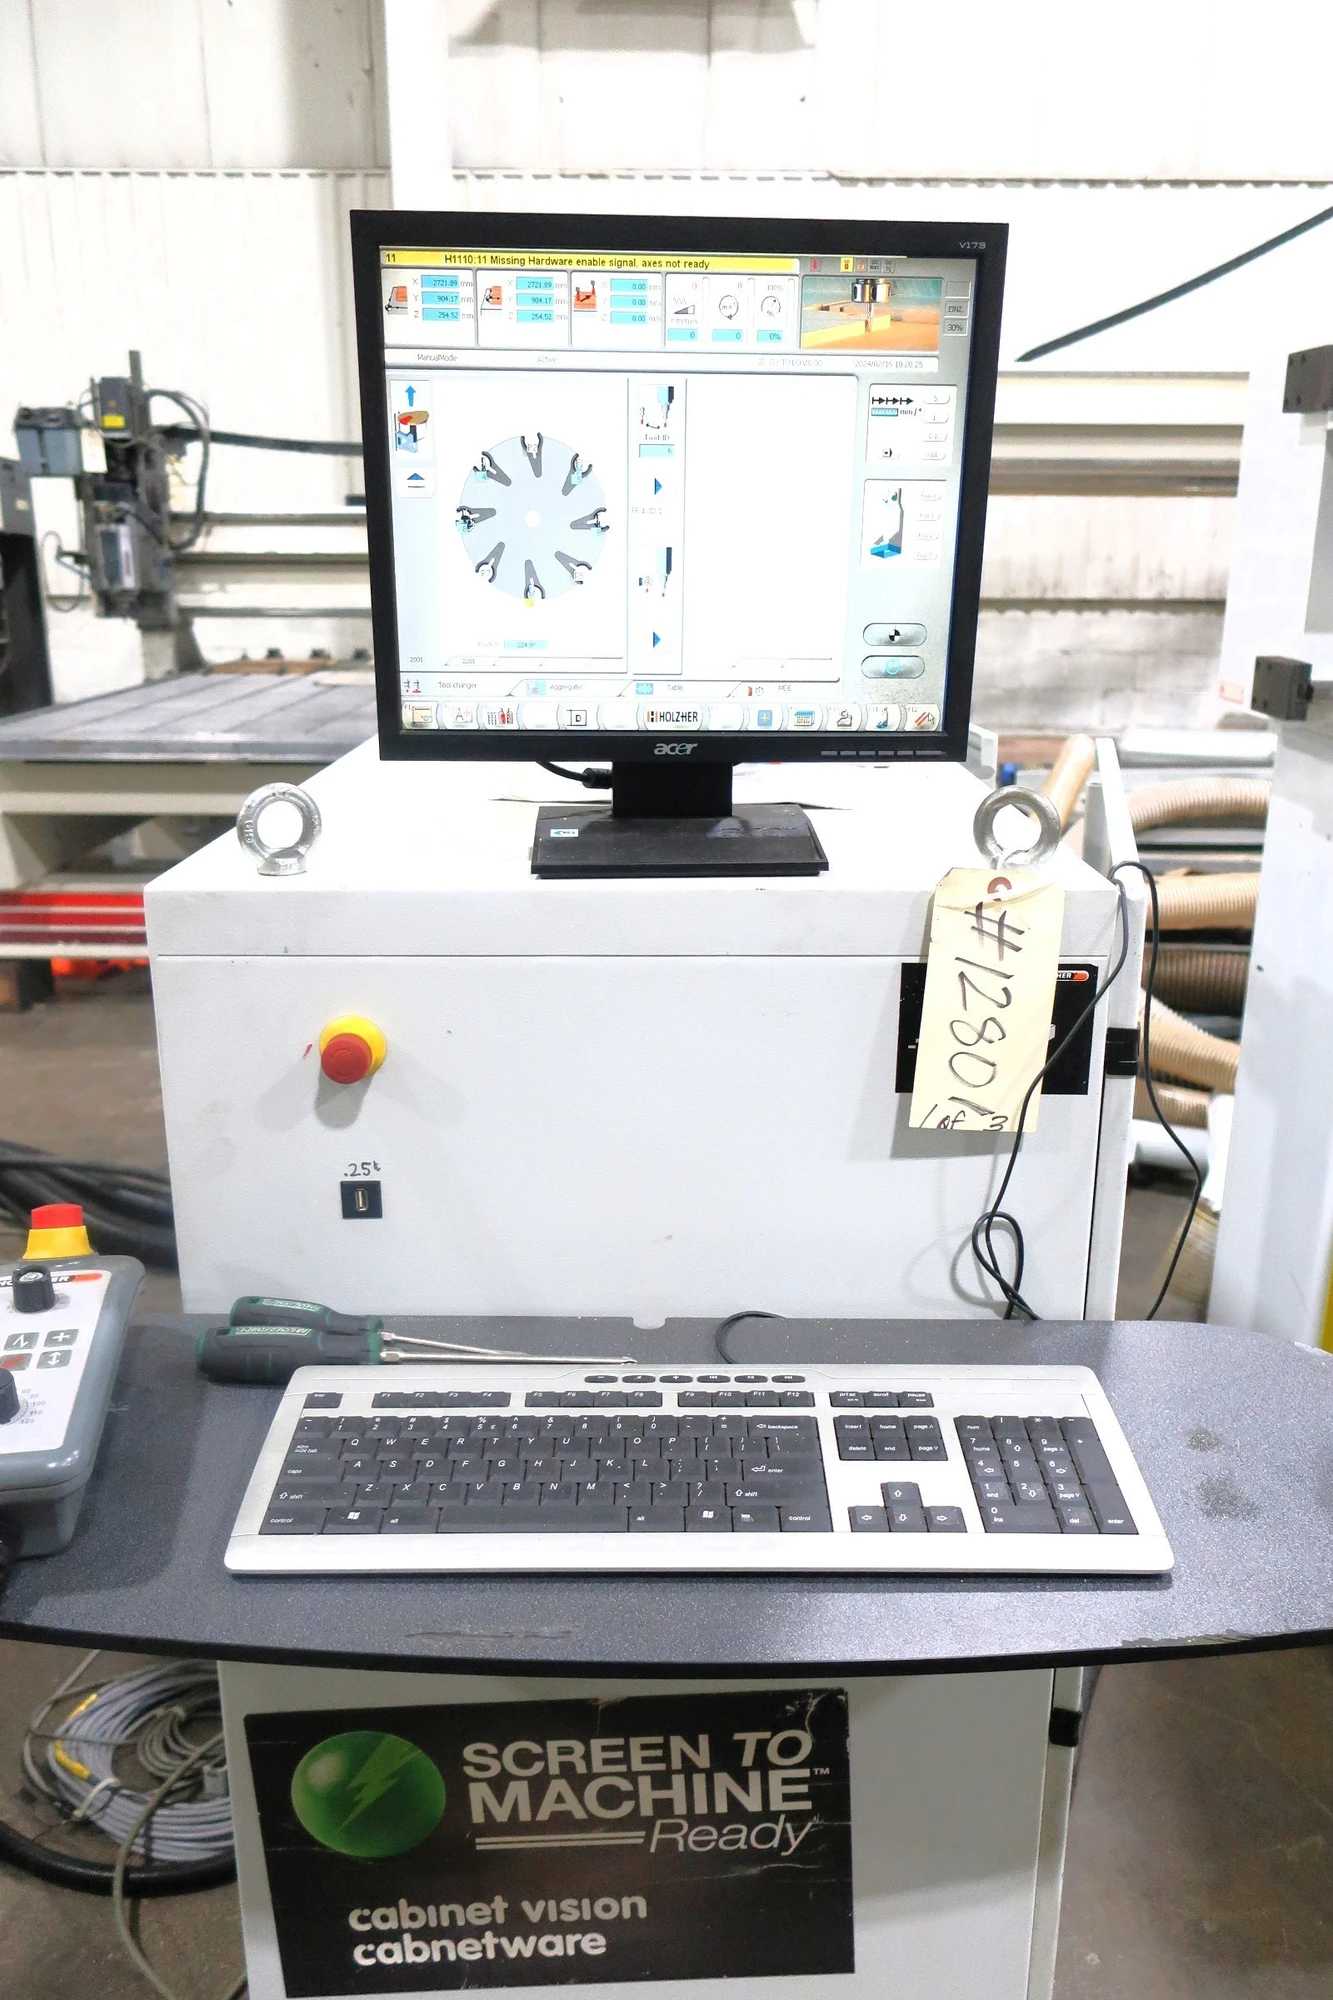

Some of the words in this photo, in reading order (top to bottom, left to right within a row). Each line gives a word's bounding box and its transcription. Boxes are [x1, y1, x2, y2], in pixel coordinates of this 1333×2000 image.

[385, 253, 396, 263] 11
[490, 255, 526, 267] Missing
[528, 256, 573, 267] Hardware
[576, 257, 606, 267] enable
[641, 259, 663, 268] axes
[665, 259, 681, 269] not
[683, 260, 710, 271] ready
[660, 711, 698, 723] HOLZHER
[653, 743, 698, 755] acer
[462, 1734, 711, 1779] SCREEN
[731, 1728, 814, 1768] TO
[467, 1768, 814, 1825] MACHINE
[649, 1813, 812, 1856] Ready
[348, 1895, 508, 1932] cabinet
[522, 1895, 648, 1924] vision
[352, 1930, 608, 1967] cabnetware
